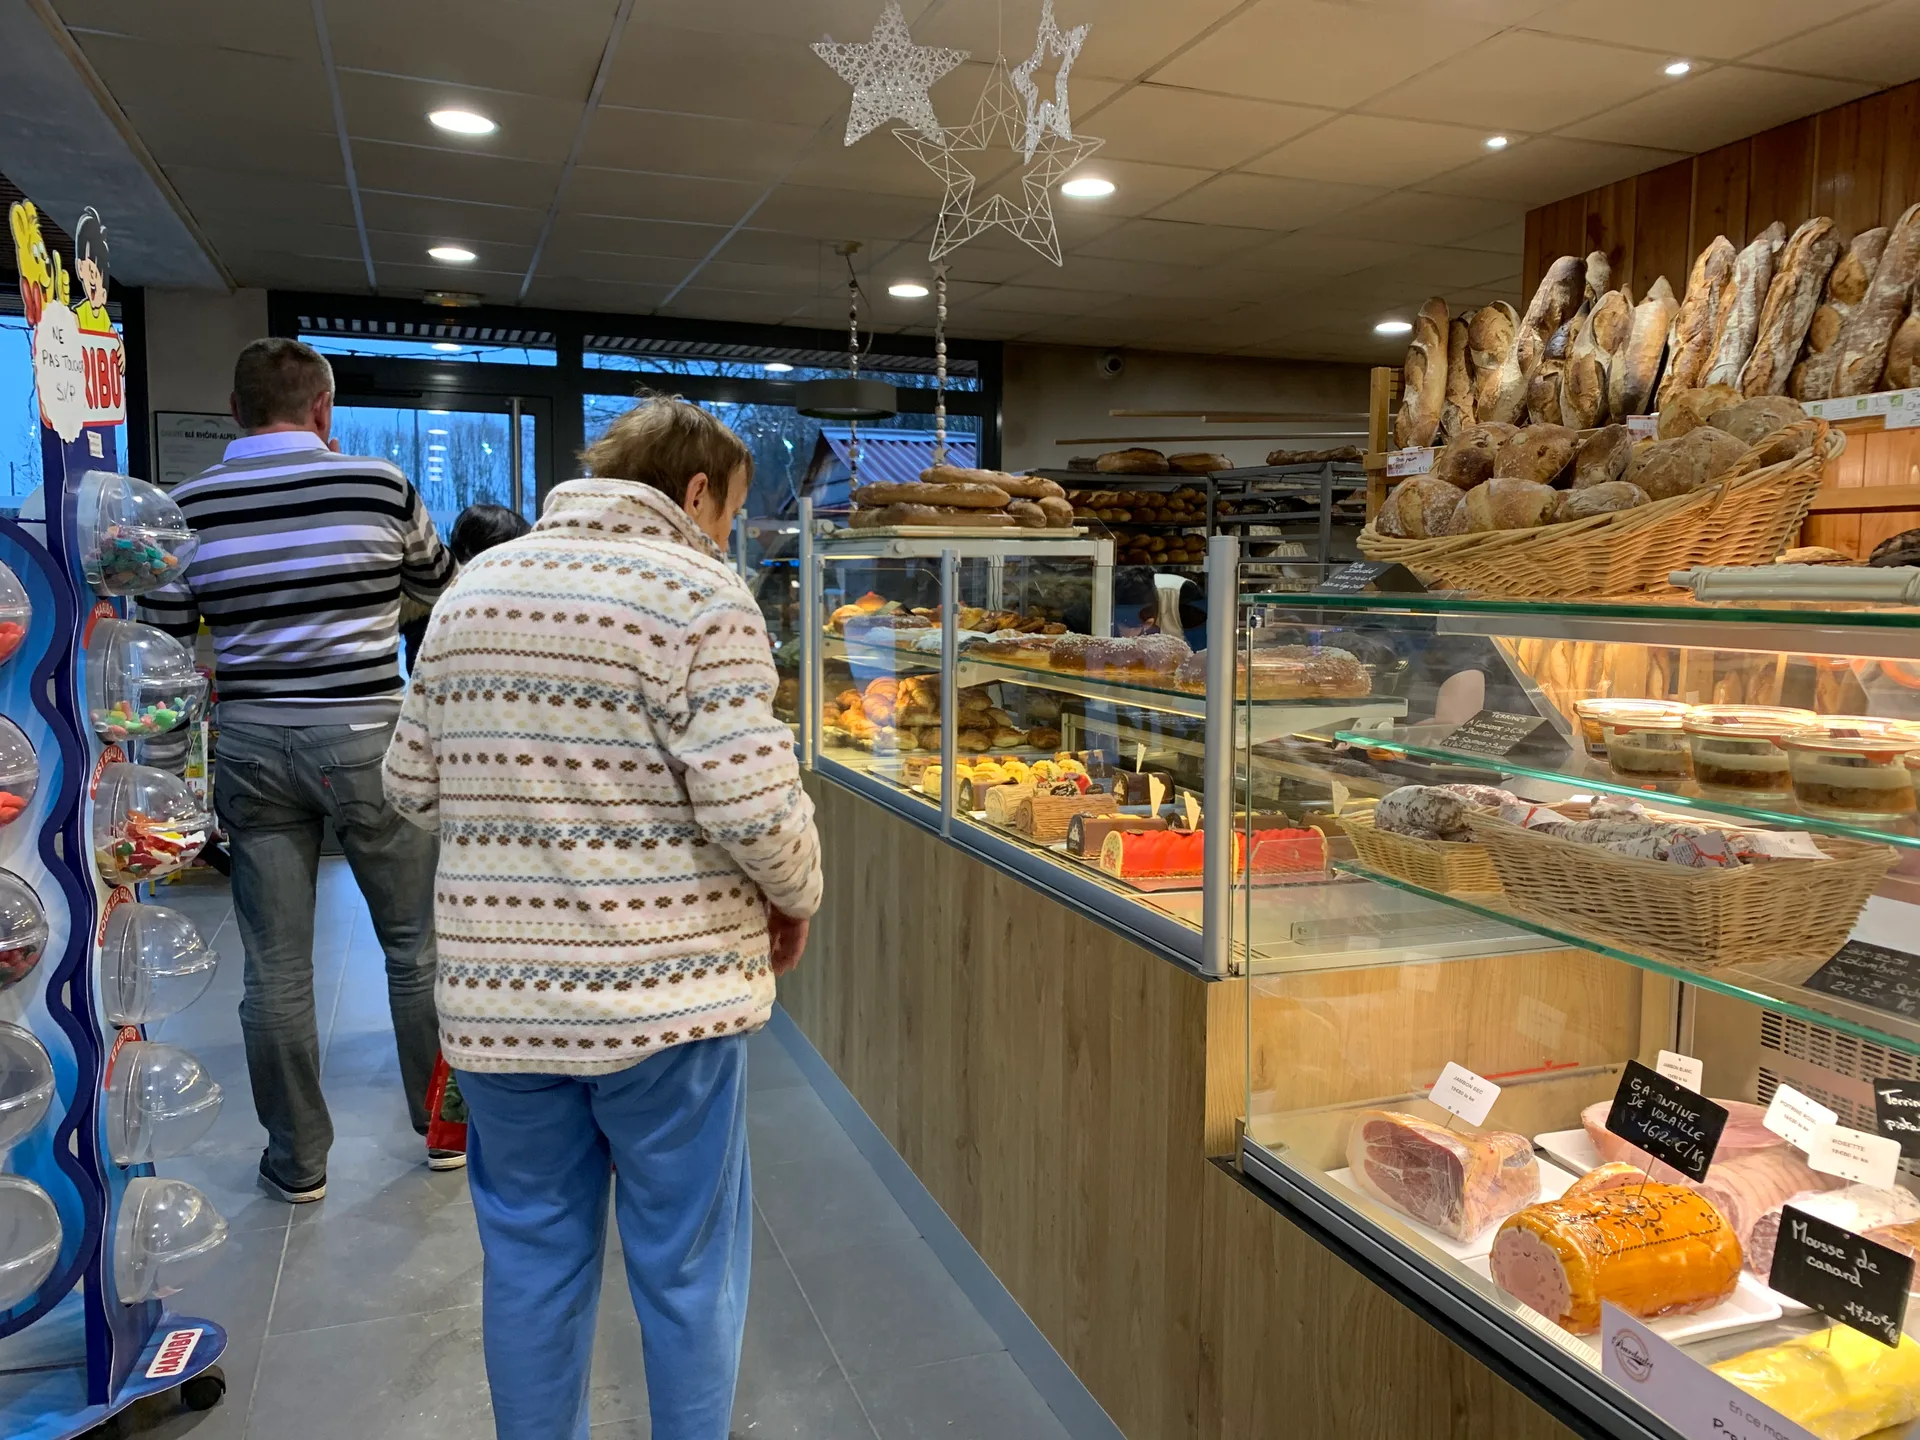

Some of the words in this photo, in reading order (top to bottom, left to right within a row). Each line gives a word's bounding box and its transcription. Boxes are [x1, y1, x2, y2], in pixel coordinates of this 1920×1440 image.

[52, 326, 64, 344] NE
[42, 349, 60, 367] PAS
[94, 602, 114, 619] HARIBO
[99, 903, 112, 941] POUR
[110, 889, 120, 908] LES
[1453, 1075, 1473, 1090] JAMBON
[1472, 1086, 1484, 1095] SEC
[1627, 1093, 1646, 1108] DE
[1831, 1138, 1866, 1152] ROSETTE
[1791, 1219, 1846, 1260] Mousse
[1855, 1248, 1881, 1275] de
[1805, 1254, 1864, 1288] canard
[153, 1332, 195, 1374] HARIBO
[1729, 1400, 1743, 1416] En
[1745, 1413, 1761, 1428] ce
